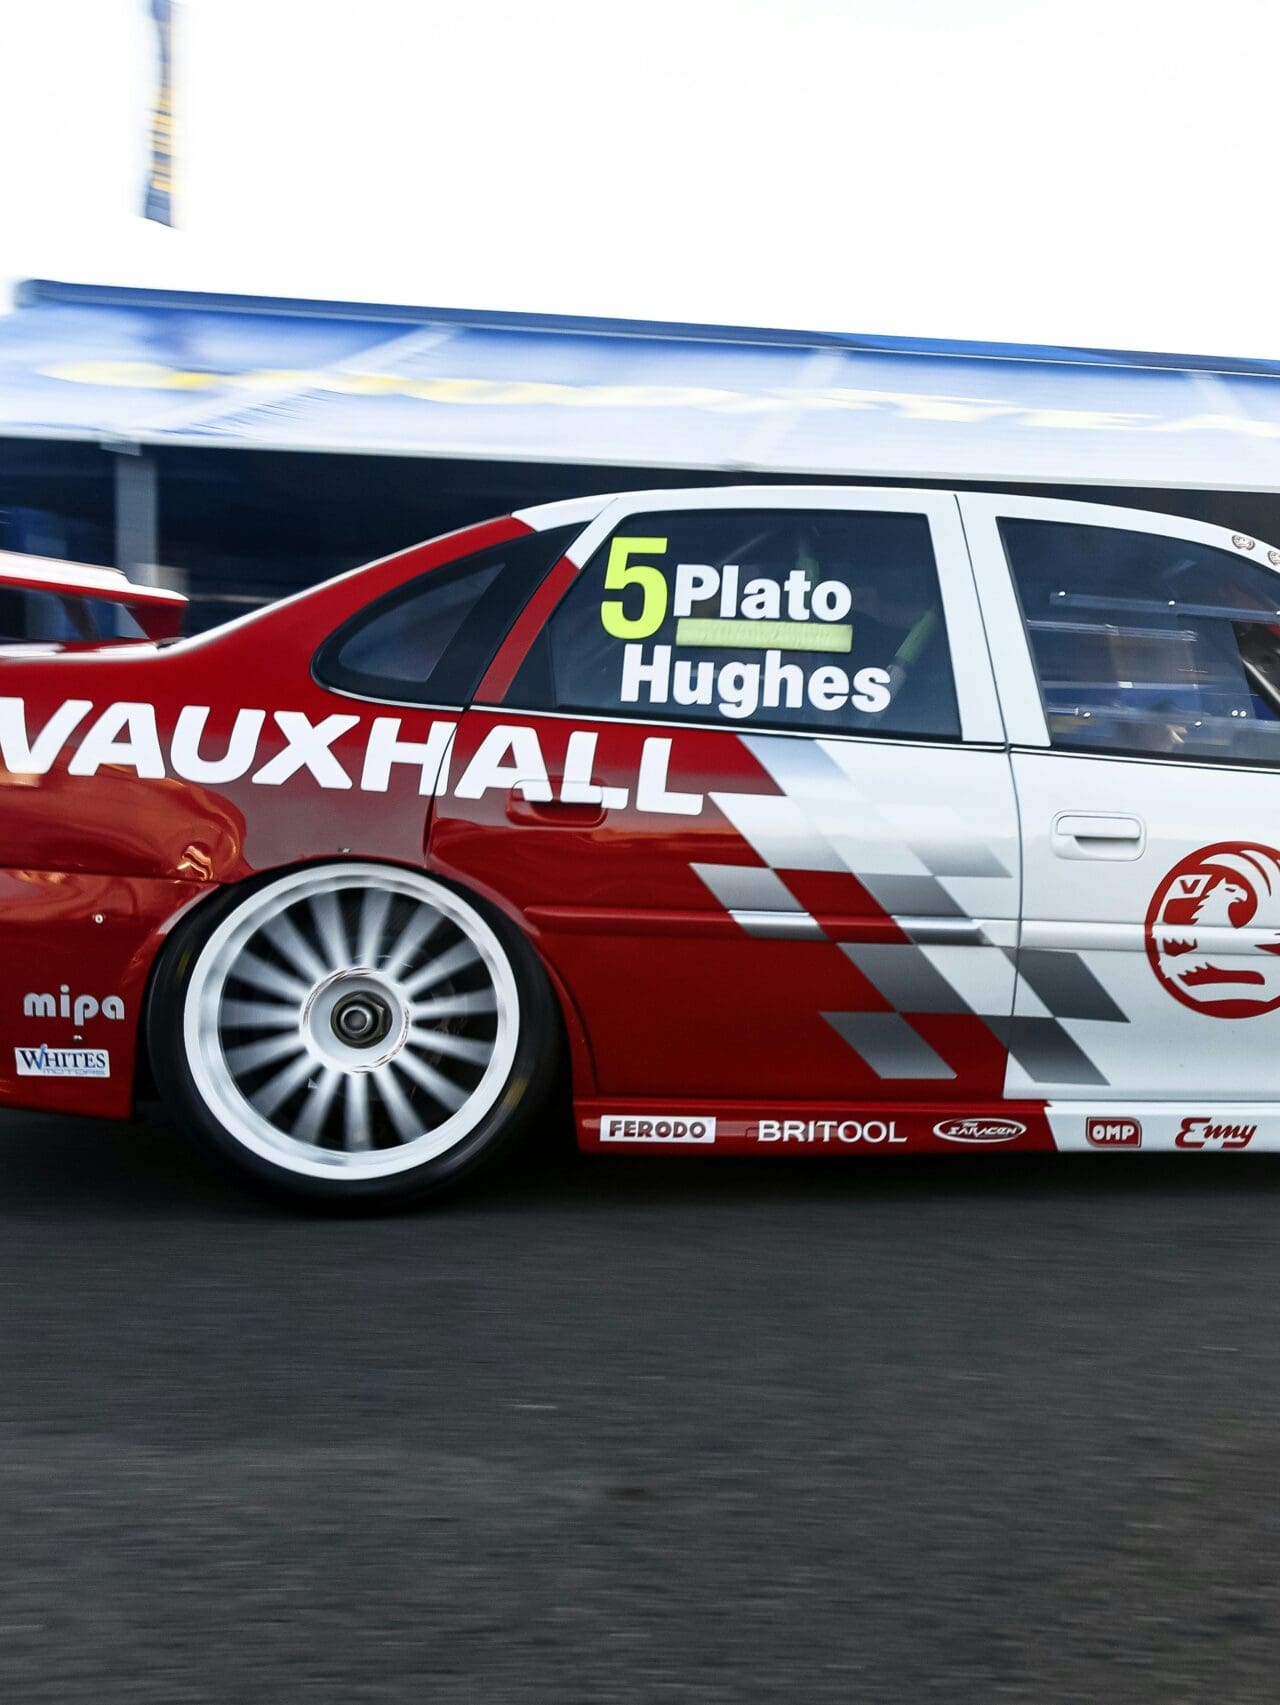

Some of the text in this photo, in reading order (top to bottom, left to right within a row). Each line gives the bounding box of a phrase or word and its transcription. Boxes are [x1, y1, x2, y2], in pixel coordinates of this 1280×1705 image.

[600, 536, 668, 639] 5
[673, 563, 852, 622] Plato
[620, 643, 891, 719] Hughes
[0, 696, 705, 816] VAUXHALL
[24, 983, 125, 1026] mipa
[19, 1047, 106, 1070] WHITES
[608, 1119, 707, 1139] FERODO
[758, 1119, 908, 1143] BRITOOL
[1092, 1124, 1135, 1141] OMP
